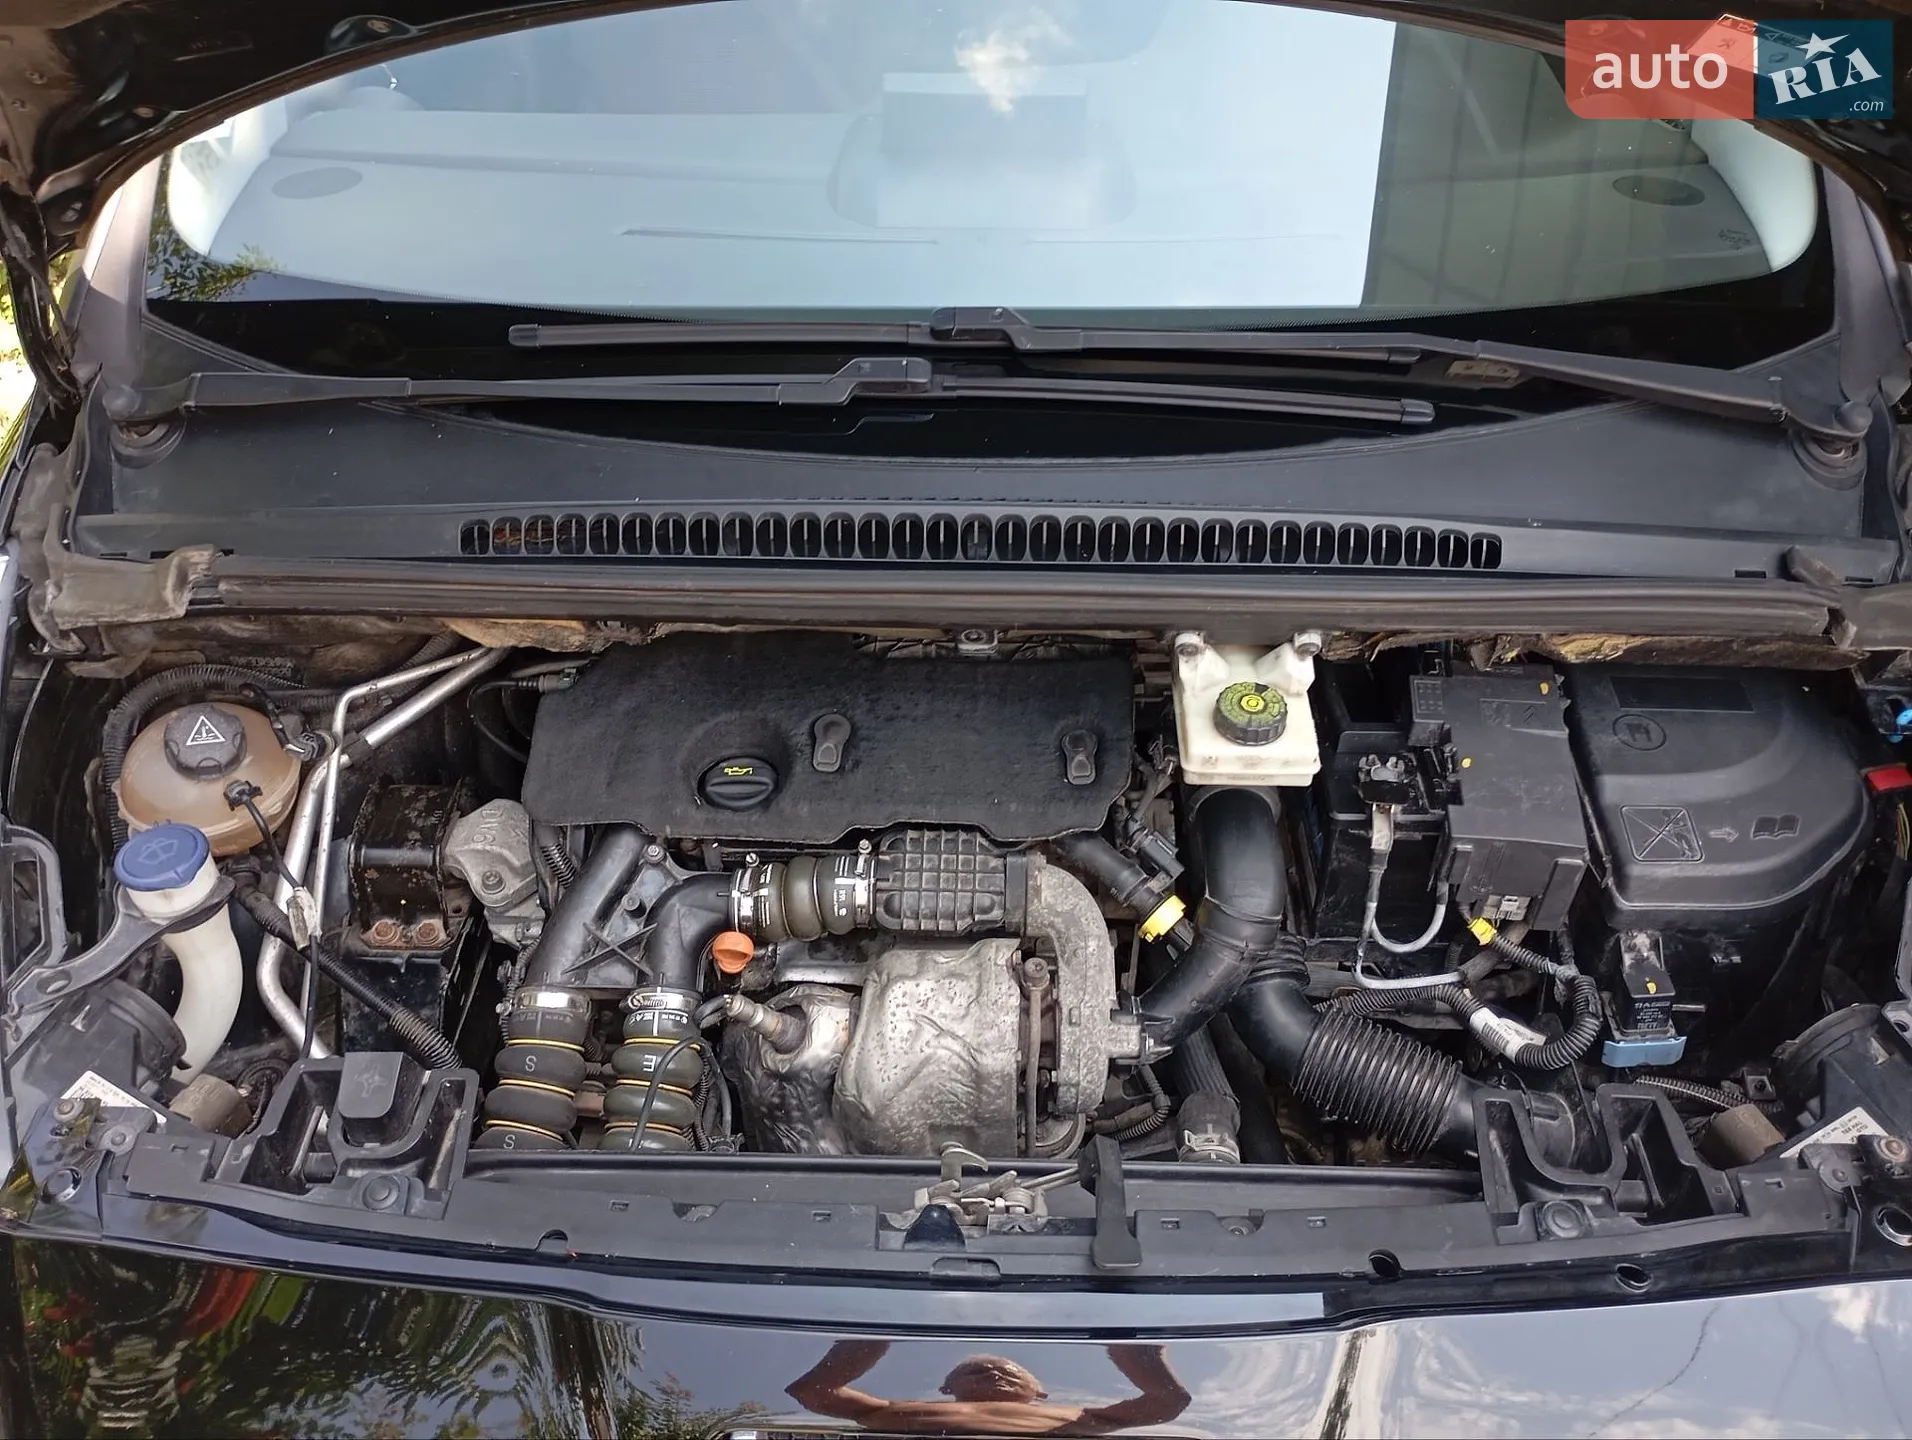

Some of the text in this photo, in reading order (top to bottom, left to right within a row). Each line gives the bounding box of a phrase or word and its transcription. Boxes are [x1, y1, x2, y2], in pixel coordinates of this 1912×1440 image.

[472, 808, 504, 844] DV6
[525, 1055, 537, 1072] S
[503, 1134, 515, 1149] S
